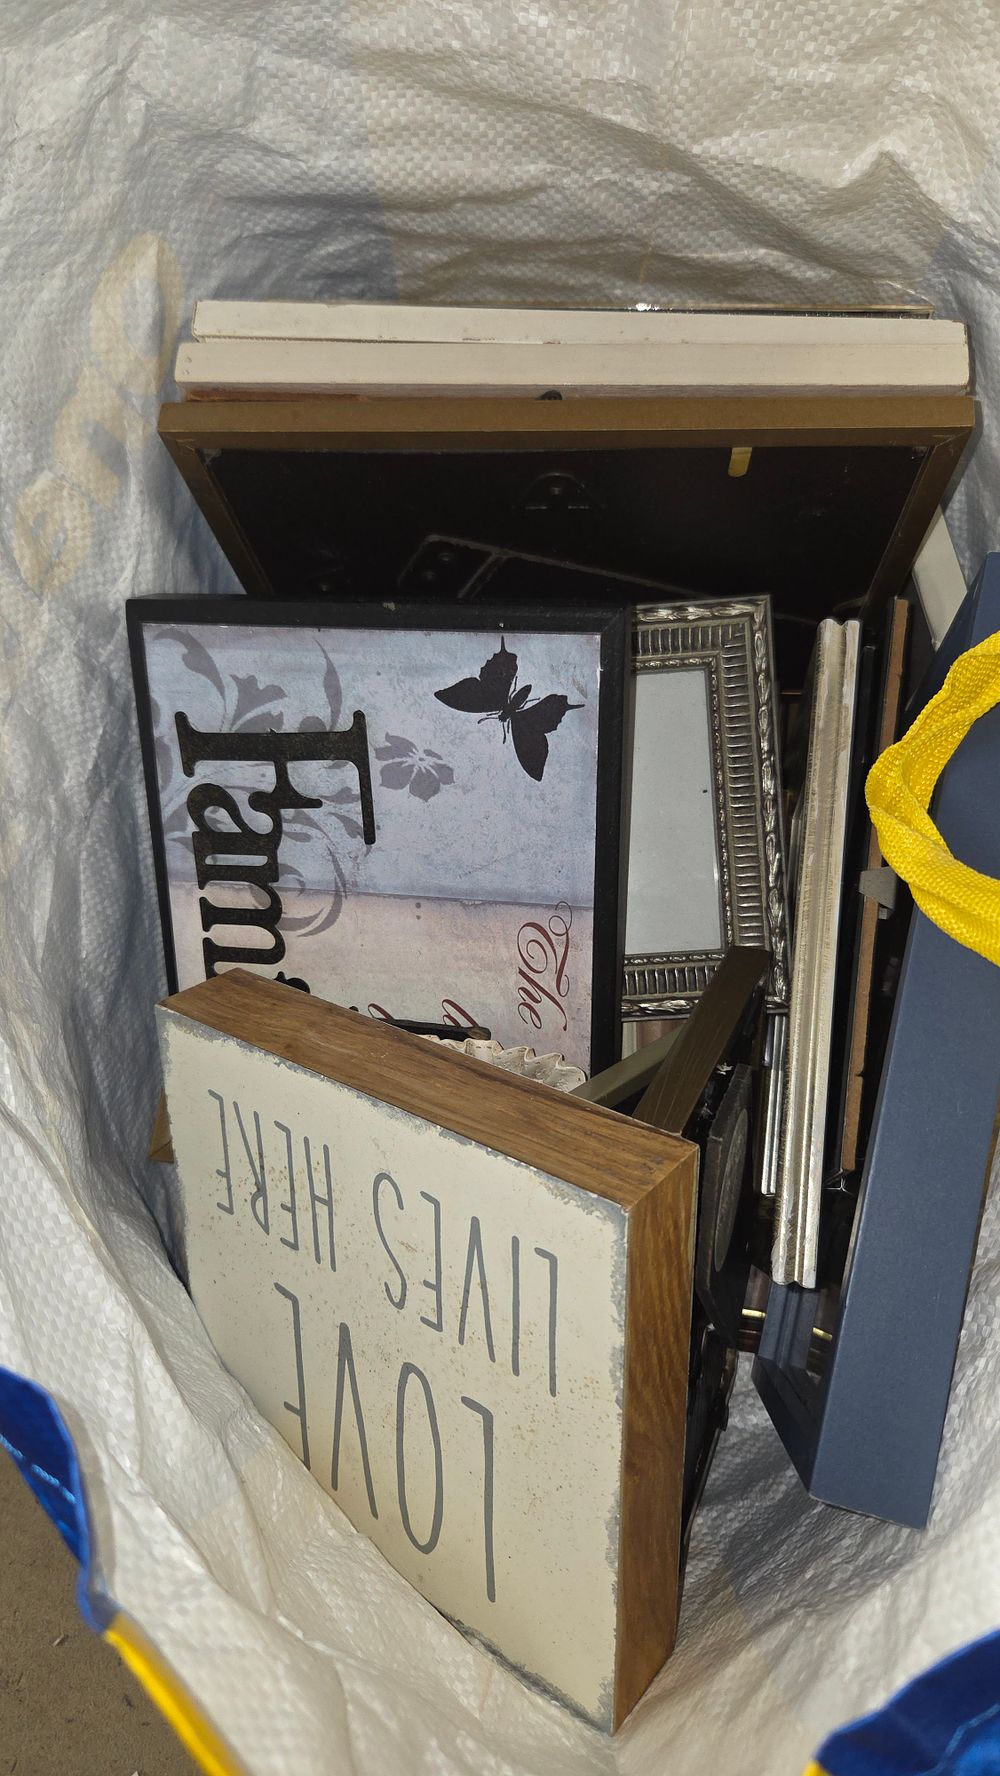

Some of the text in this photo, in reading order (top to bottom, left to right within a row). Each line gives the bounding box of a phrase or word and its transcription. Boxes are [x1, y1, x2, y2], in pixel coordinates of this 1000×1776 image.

[175, 709, 377, 996] Fam
[516, 901, 573, 1032] The
[207, 1088, 558, 1398] LIVES HERE
[273, 1281, 496, 1603] LOVE
